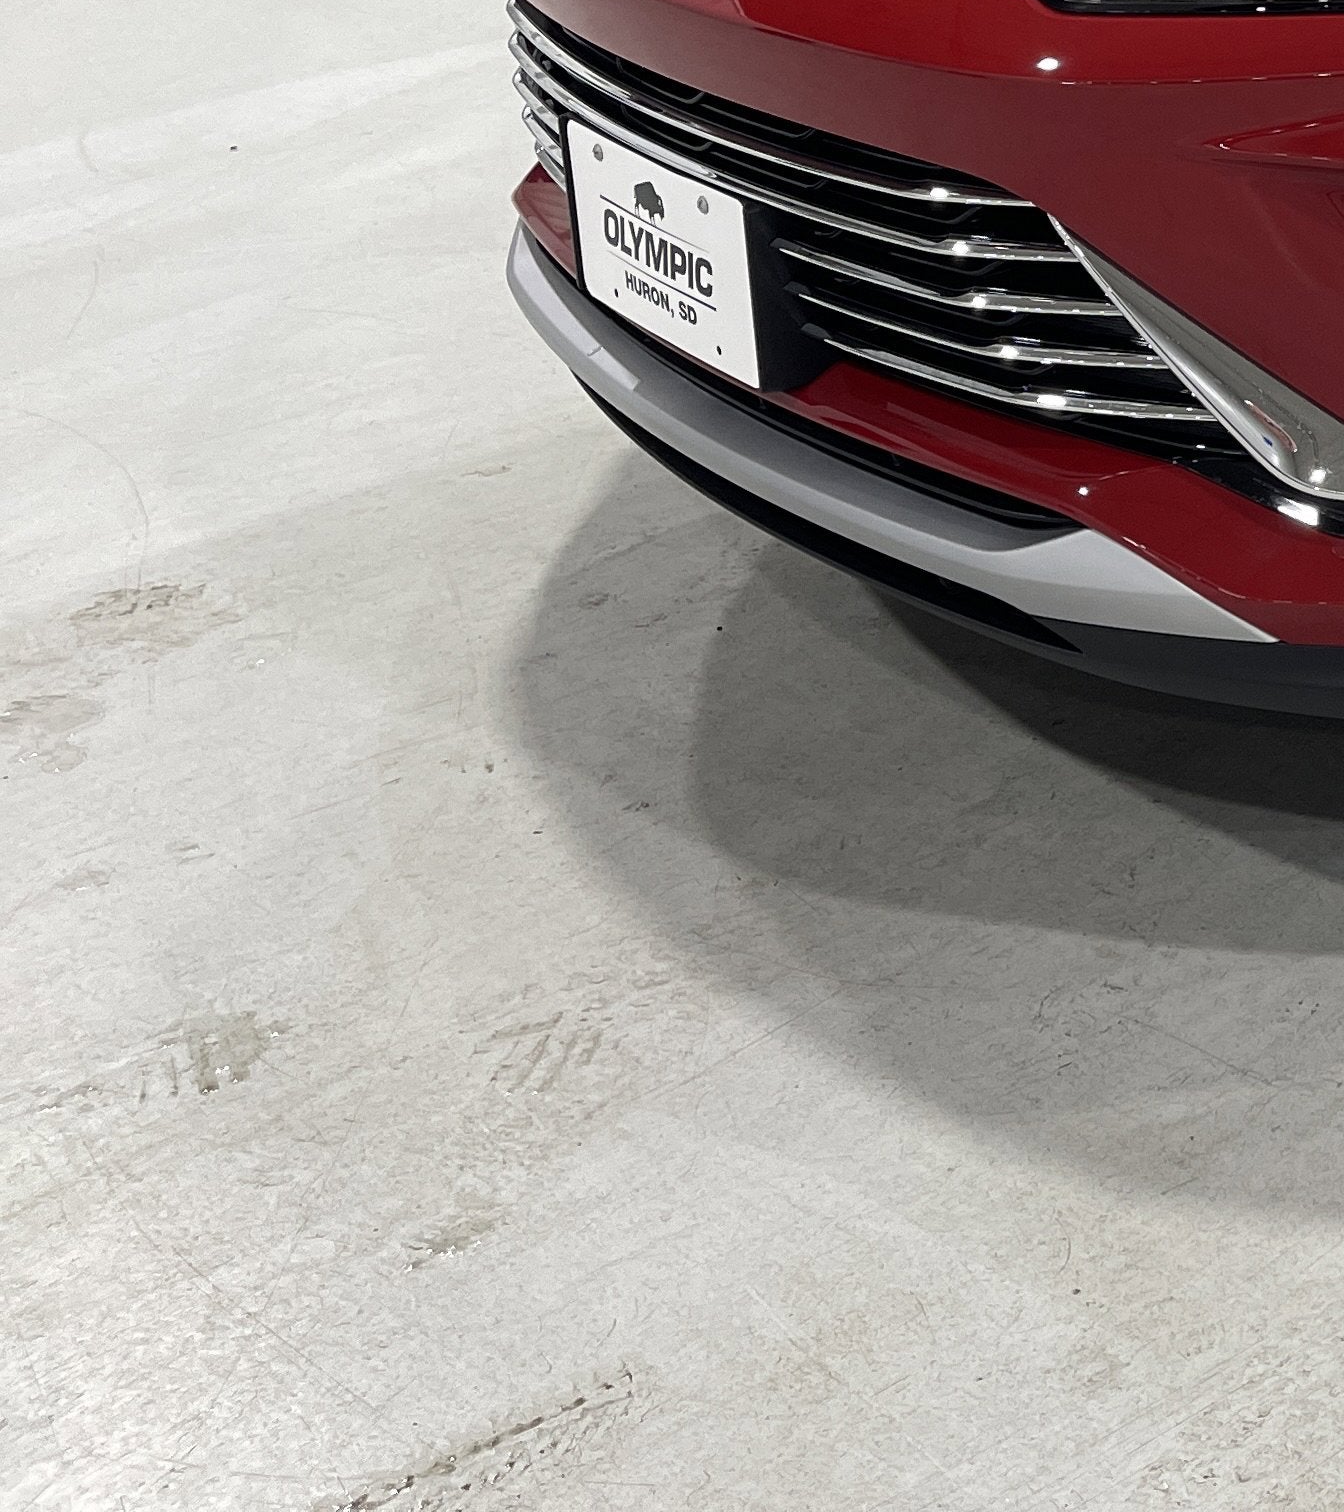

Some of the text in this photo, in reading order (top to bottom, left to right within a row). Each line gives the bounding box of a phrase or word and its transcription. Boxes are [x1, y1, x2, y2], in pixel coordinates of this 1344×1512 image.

[604, 208, 713, 298] OLYMPIC
[624, 269, 698, 325] HURON, SD
